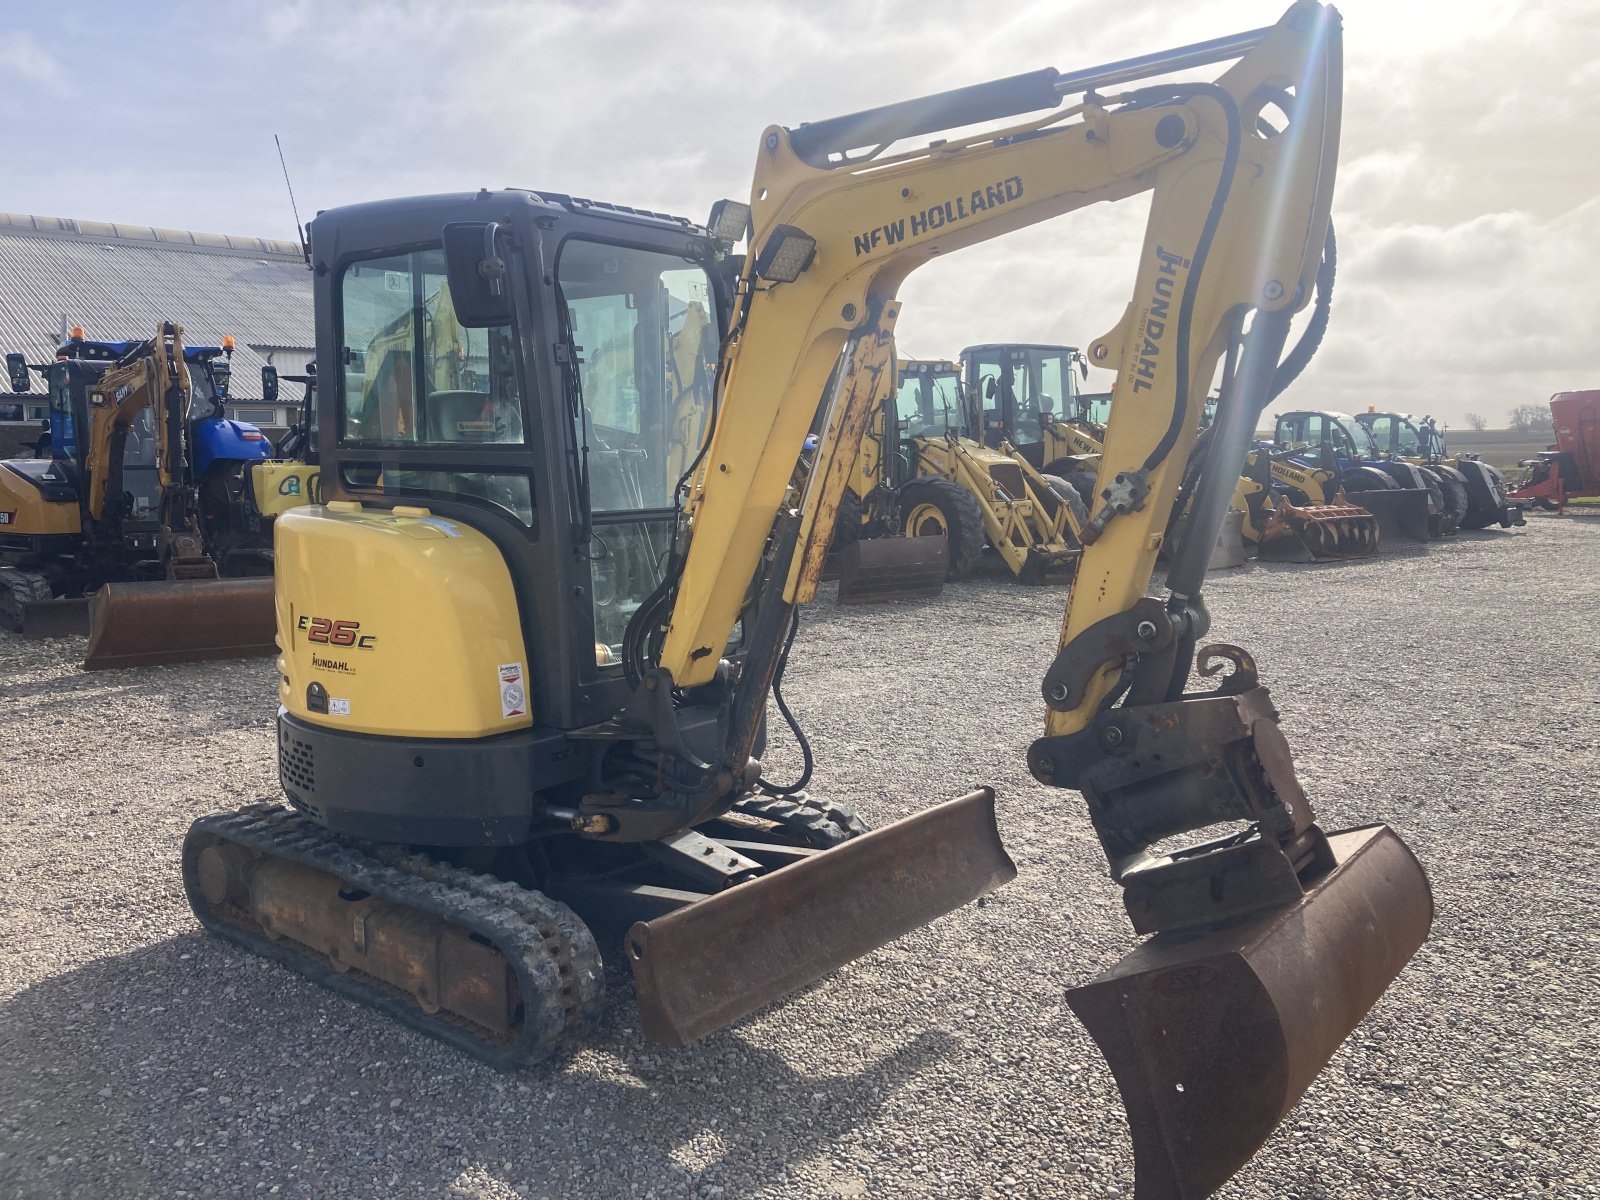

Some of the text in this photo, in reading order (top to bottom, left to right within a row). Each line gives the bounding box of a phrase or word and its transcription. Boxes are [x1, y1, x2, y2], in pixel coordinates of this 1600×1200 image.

[910, 175, 1024, 237] HOLLAND
[1073, 436, 1092, 453] NEW
[1272, 464, 1306, 483] HOLLAND
